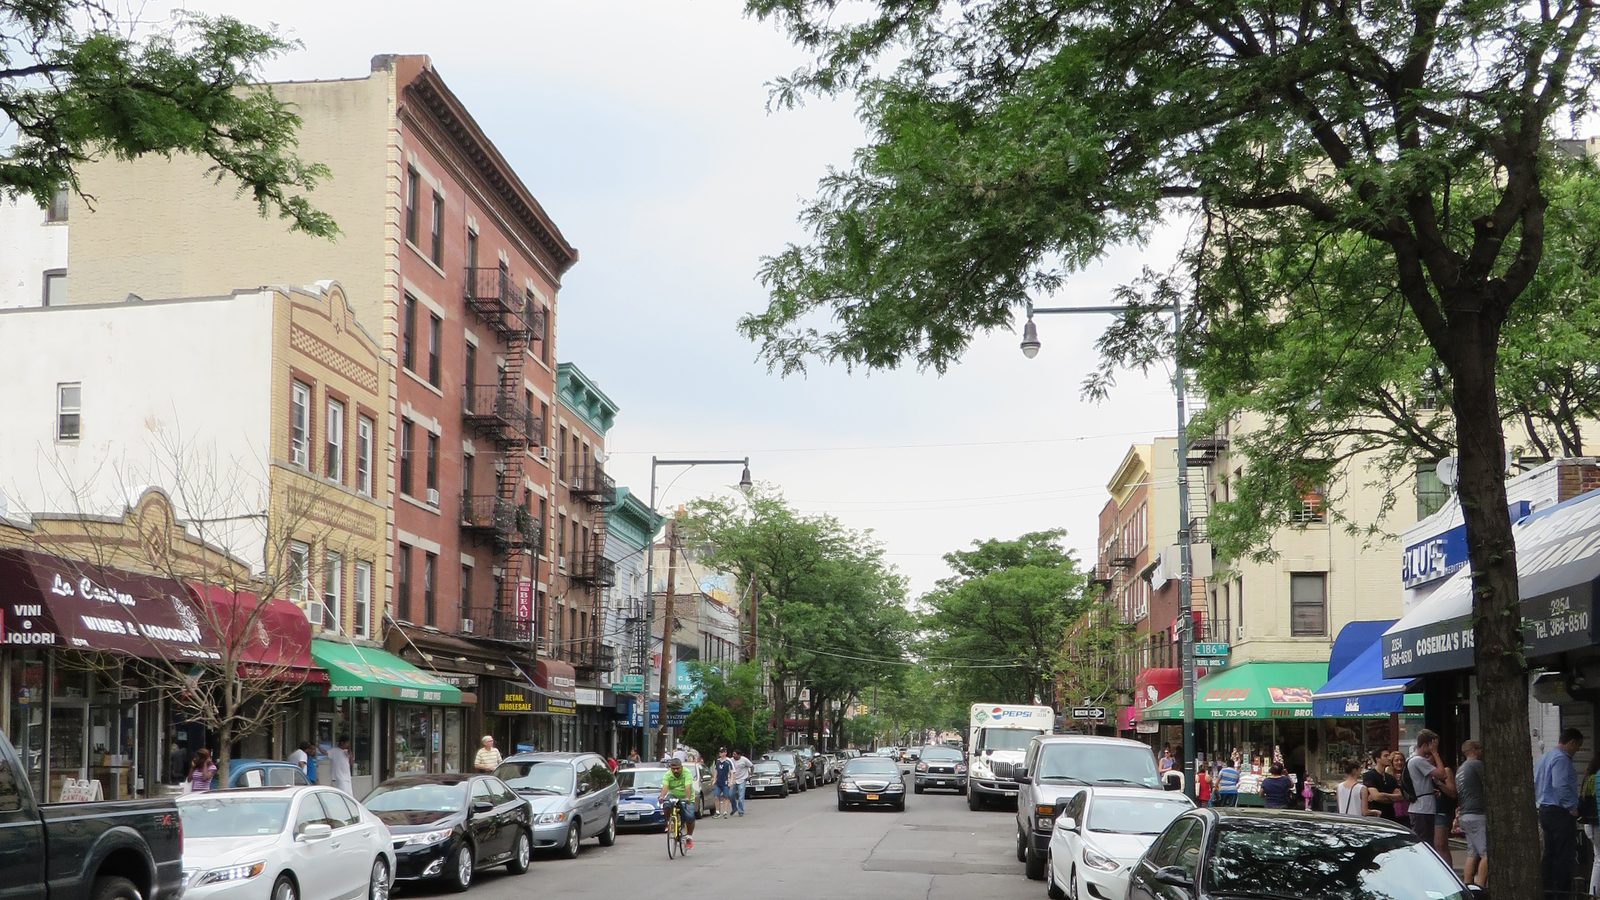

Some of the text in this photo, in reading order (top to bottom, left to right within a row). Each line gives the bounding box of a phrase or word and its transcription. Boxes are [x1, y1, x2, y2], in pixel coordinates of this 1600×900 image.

[52, 573, 75, 596] La
[14, 604, 42, 616] VINI
[23, 620, 32, 629] e
[1550, 611, 1588, 636] 364-8510
[81, 615, 193, 643] WINES & LIQUORS
[1195, 645, 1201, 654] E
[1203, 645, 1217, 654] 186
[1416, 632, 1459, 657] COSENZA'S
[505, 694, 524, 702] RETAIL
[498, 703, 531, 711] WHOLESALE
[1002, 710, 1032, 718] PEPSI
